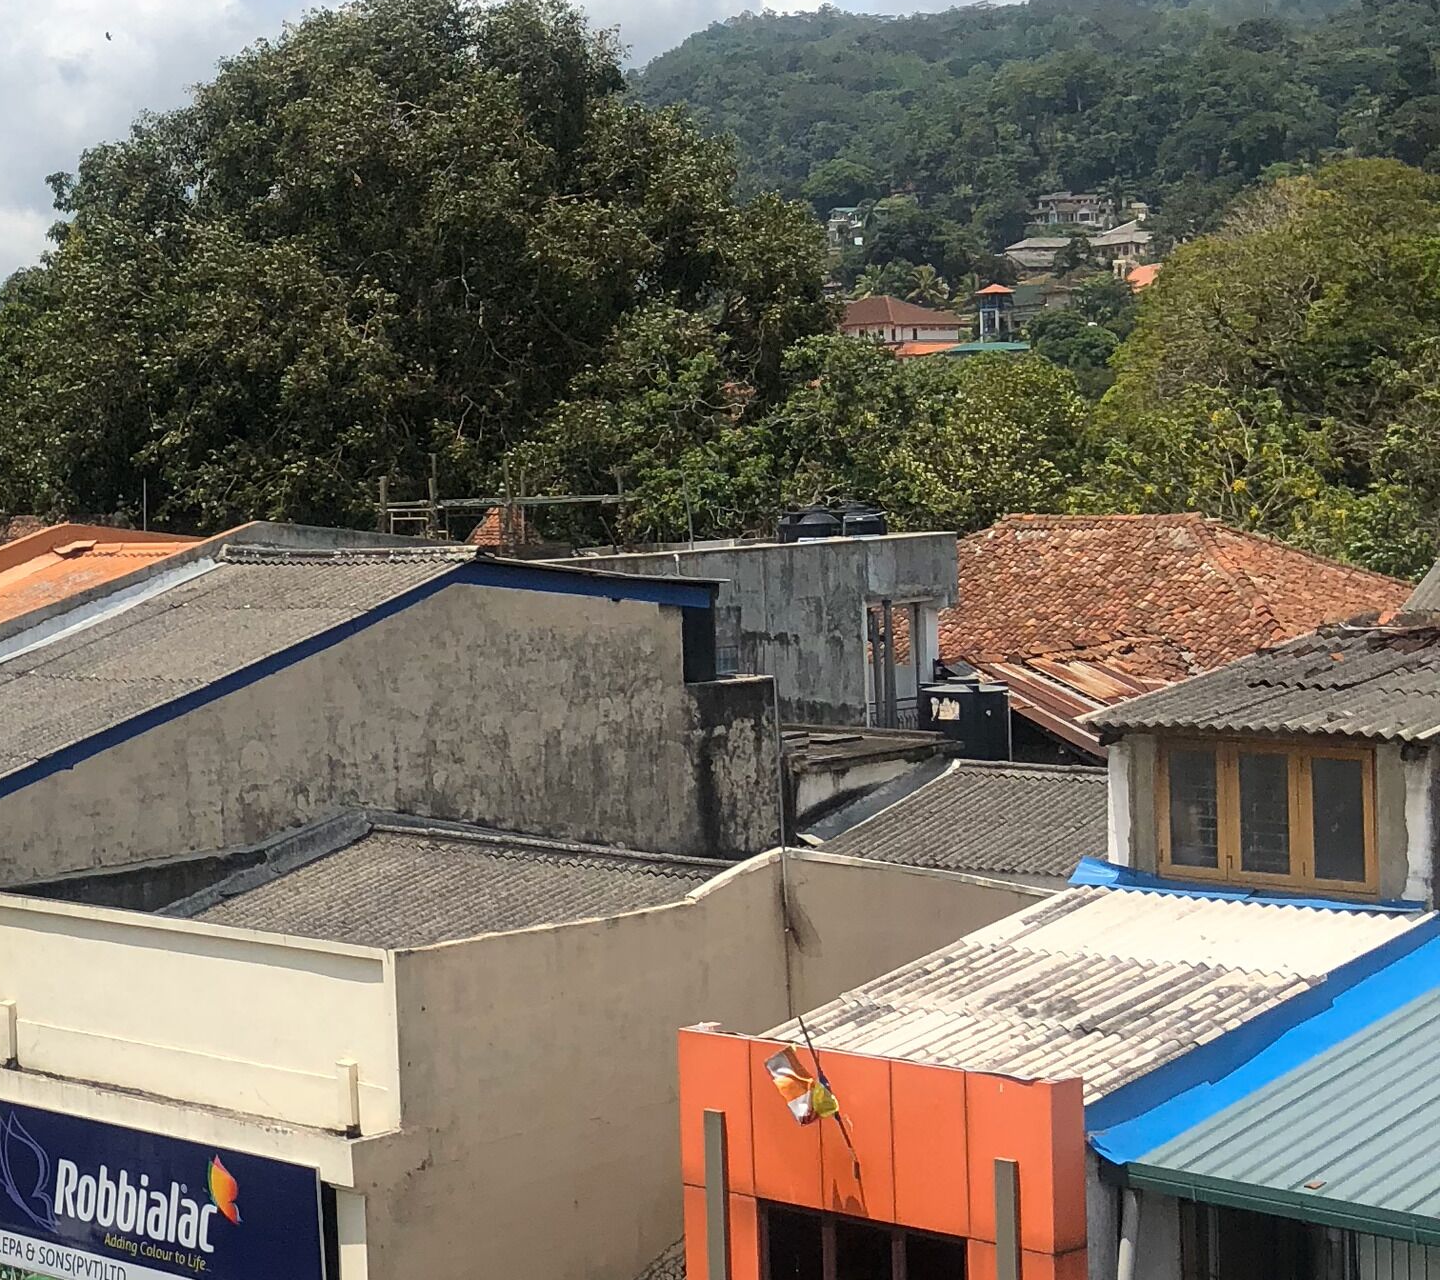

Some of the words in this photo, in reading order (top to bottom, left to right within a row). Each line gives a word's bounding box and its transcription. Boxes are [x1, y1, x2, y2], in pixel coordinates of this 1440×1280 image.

[54, 1158, 218, 1253] Robbialac
[25, 1243, 35, 1261] &
[104, 1233, 138, 1256] Adding
[140, 1241, 173, 1261] Colour
[175, 1251, 186, 1265] to
